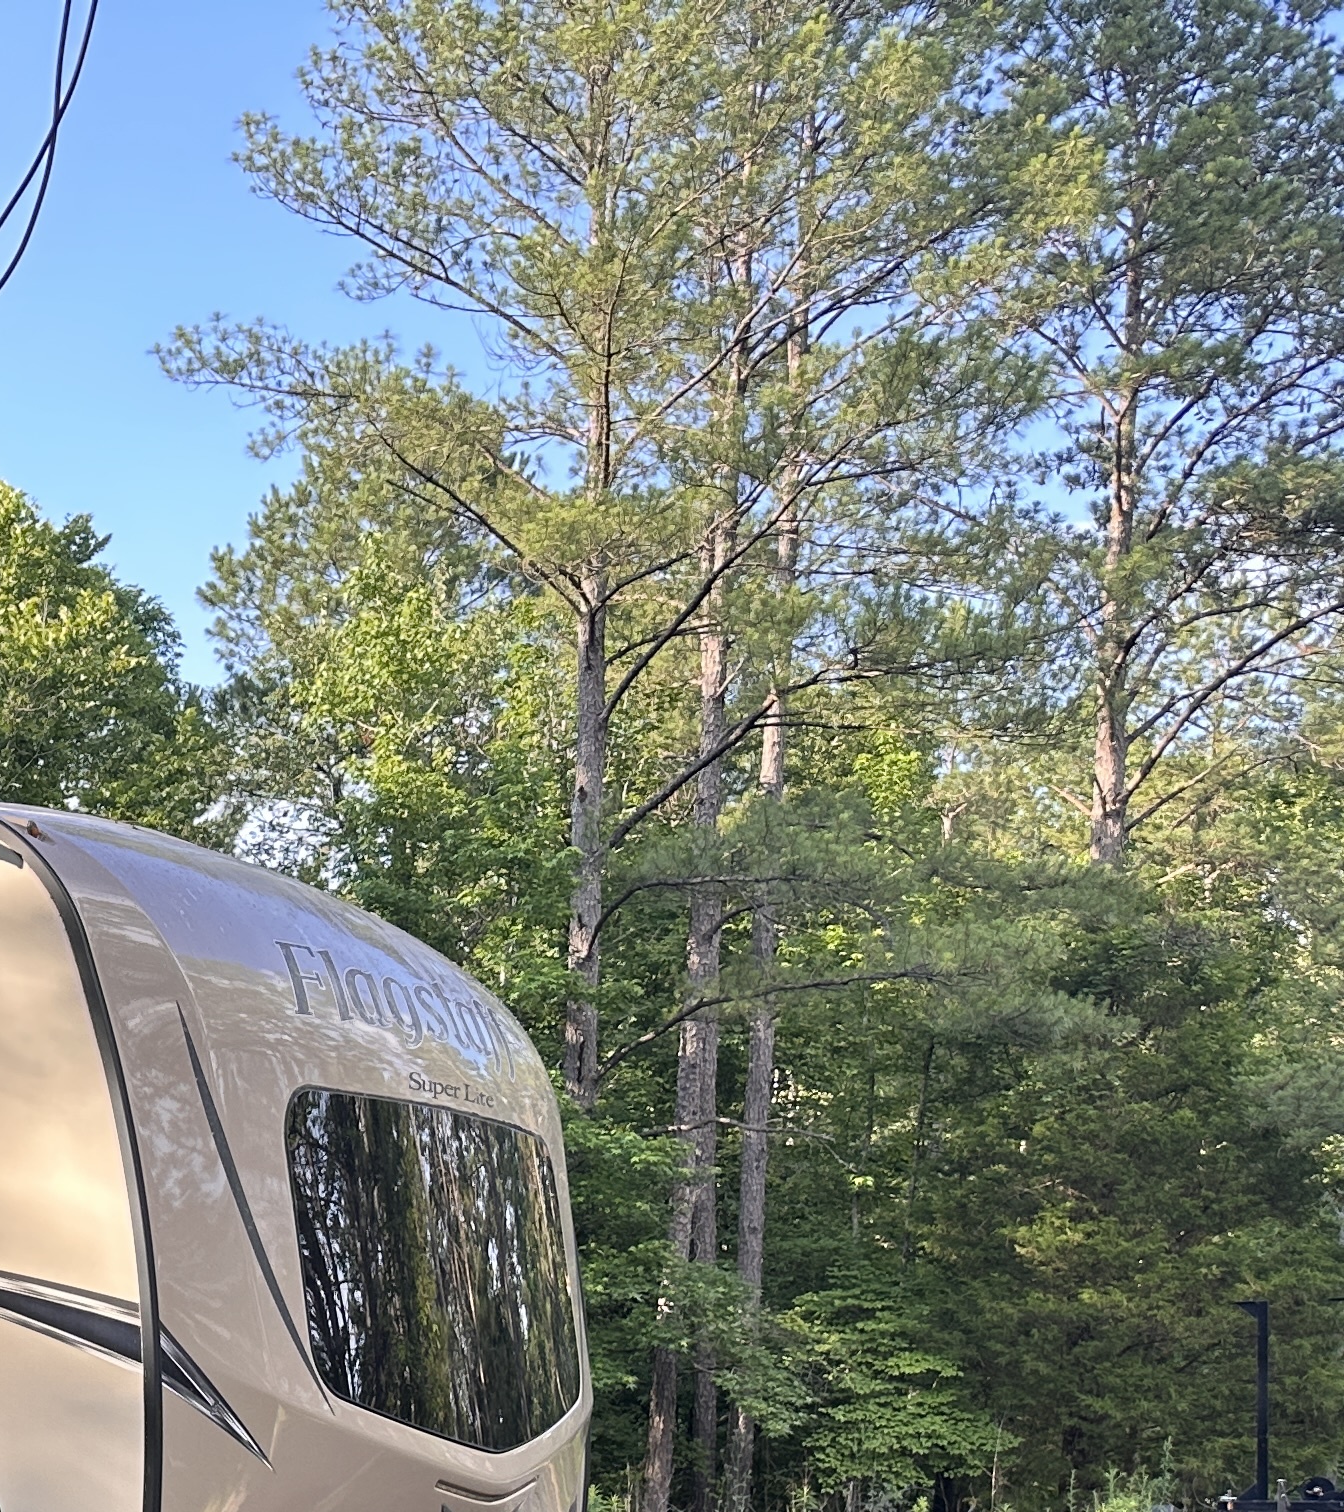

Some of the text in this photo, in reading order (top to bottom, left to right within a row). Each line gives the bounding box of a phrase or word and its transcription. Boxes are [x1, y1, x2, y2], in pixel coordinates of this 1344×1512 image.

[274, 938, 517, 1083] Flagstaff
[408, 1071, 495, 1108] Super Lite
